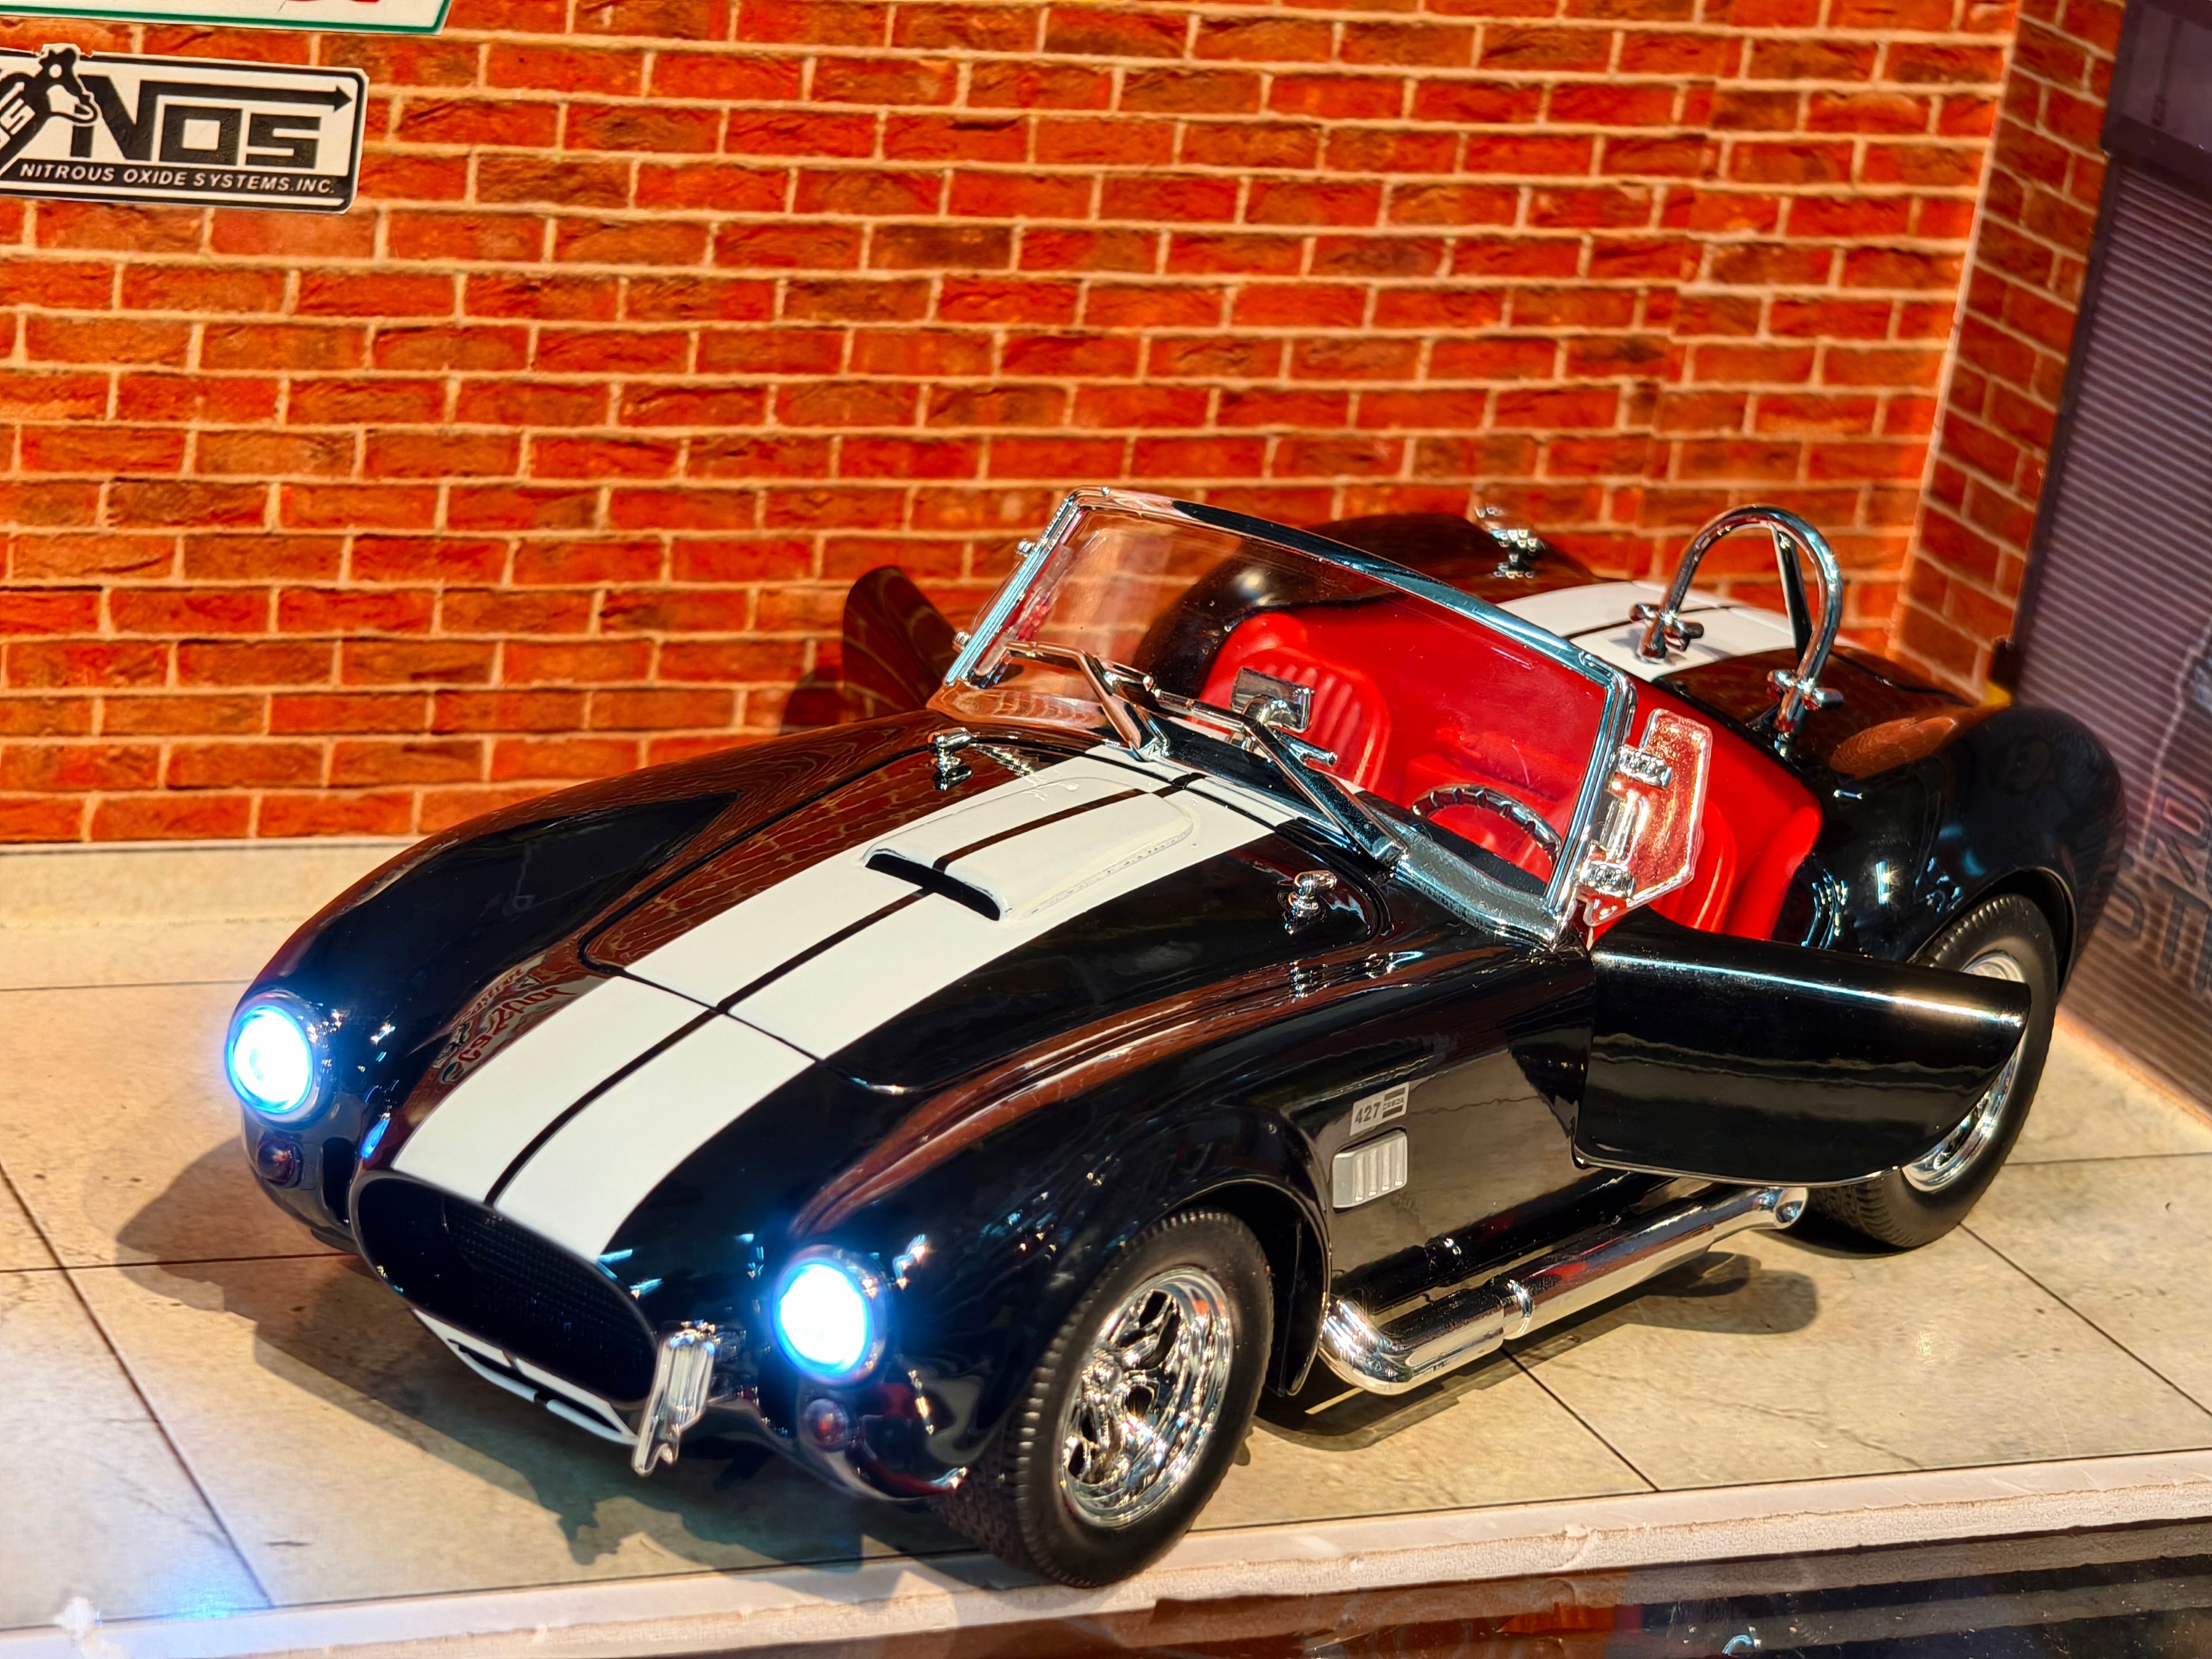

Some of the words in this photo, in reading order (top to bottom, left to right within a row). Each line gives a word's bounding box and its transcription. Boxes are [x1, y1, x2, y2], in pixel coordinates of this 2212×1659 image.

[70, 74, 321, 169] NOS
[20, 163, 115, 182] NITROUS
[123, 169, 188, 186] OXIDE
[1354, 1101, 1381, 1124] 427
